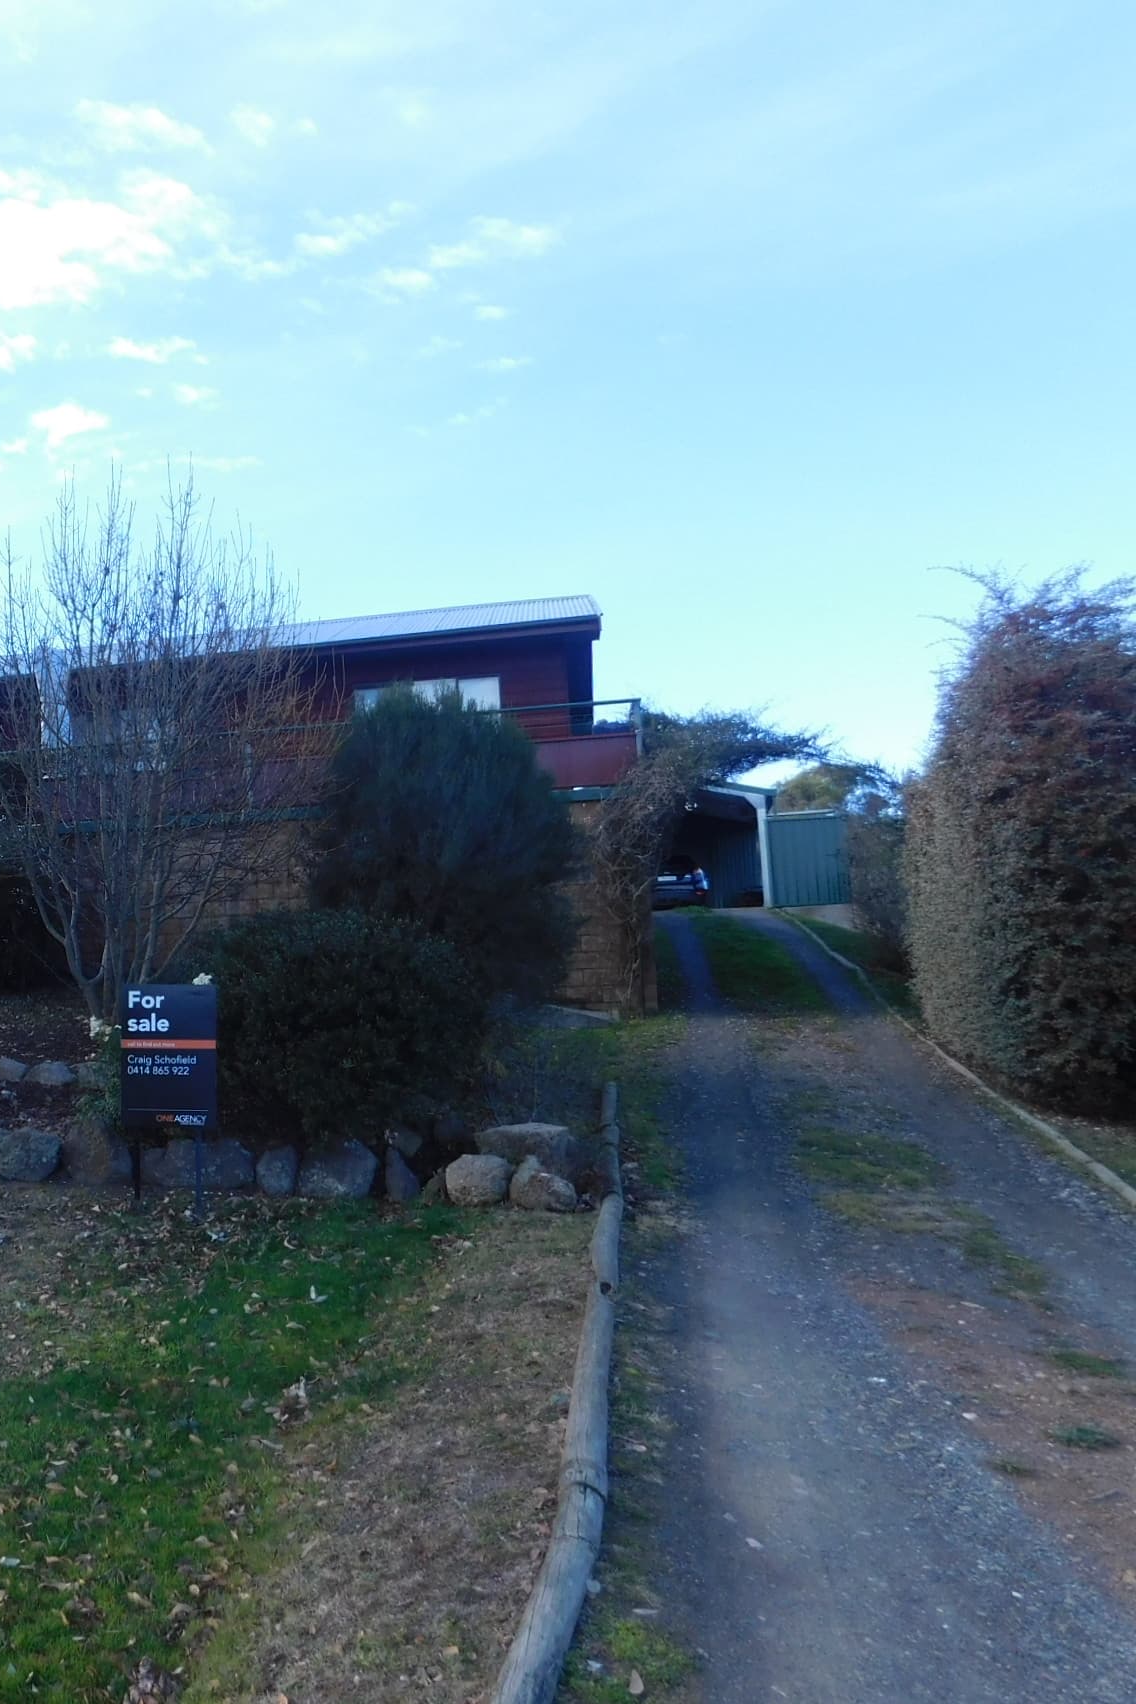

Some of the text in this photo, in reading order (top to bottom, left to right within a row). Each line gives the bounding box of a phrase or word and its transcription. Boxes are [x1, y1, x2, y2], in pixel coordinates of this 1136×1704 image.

[128, 990, 165, 1009] For
[127, 1012, 170, 1032] sale
[127, 1054, 197, 1066] Craig Schofield
[127, 1066, 190, 1076] 0414 865 922
